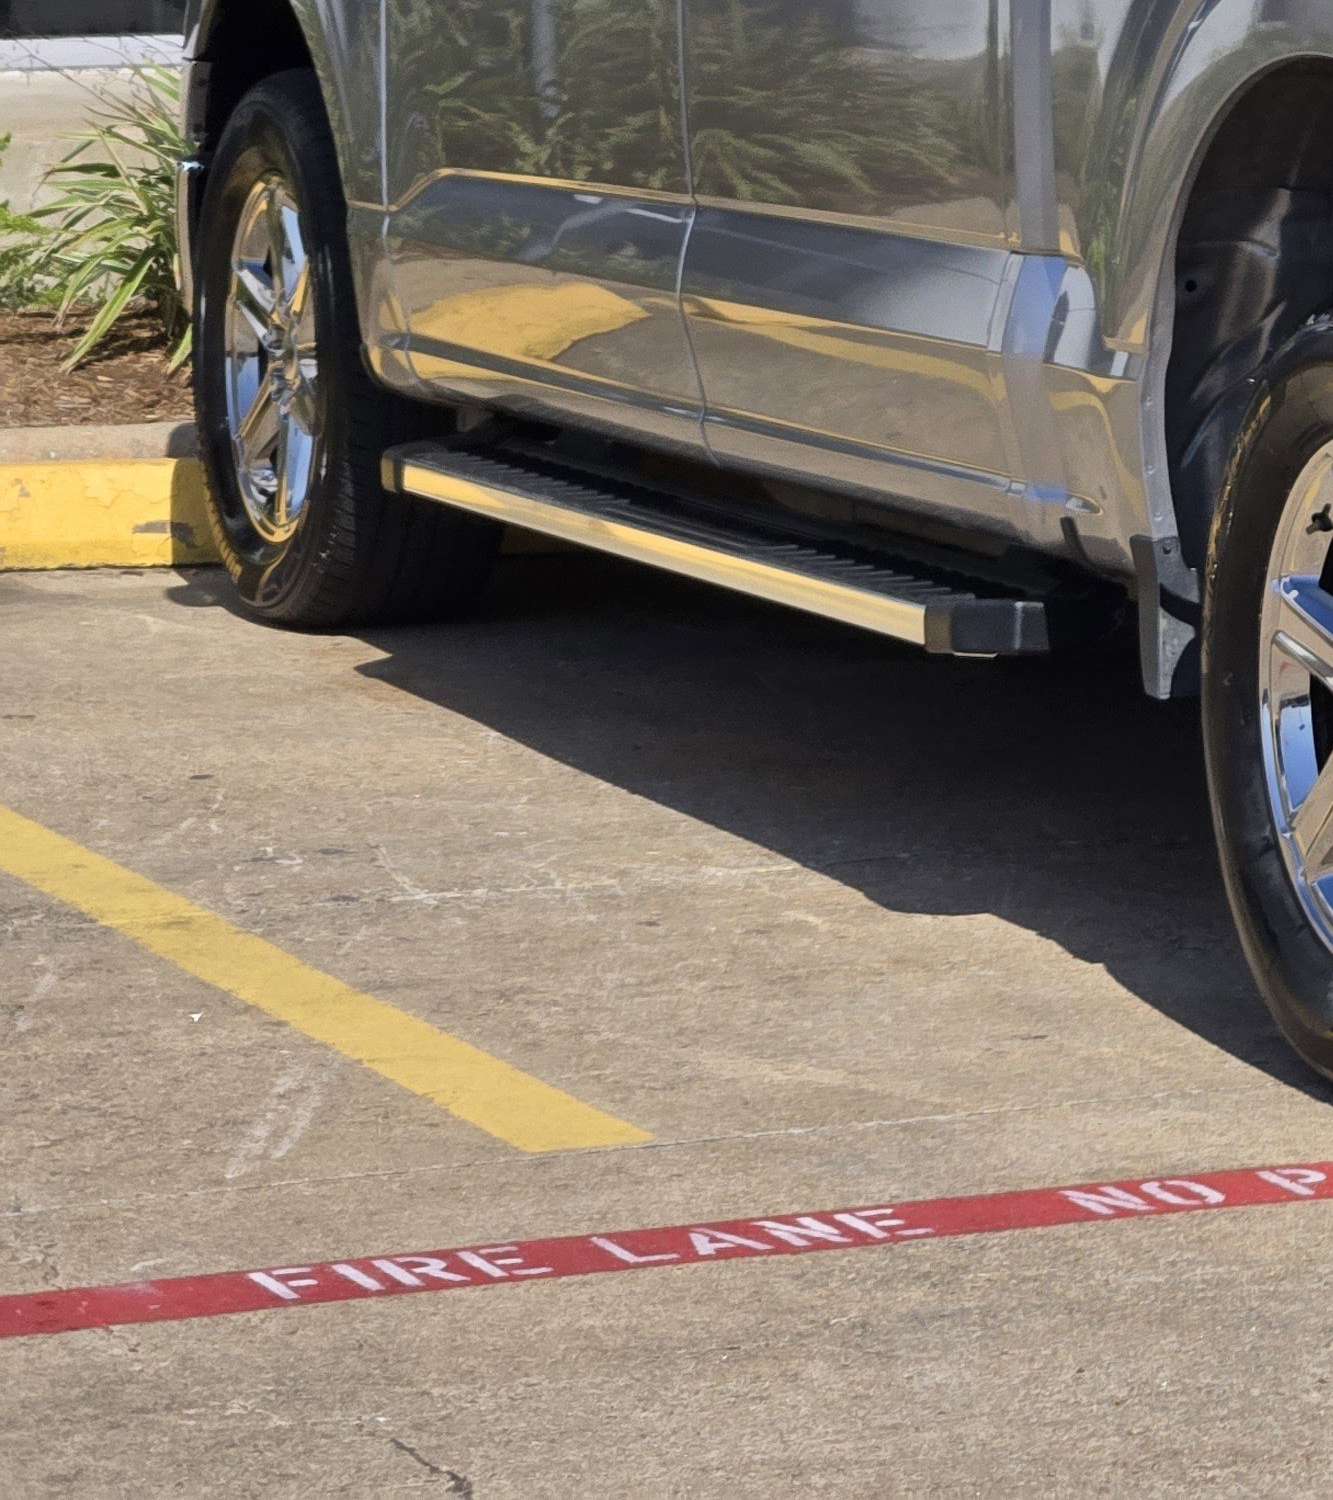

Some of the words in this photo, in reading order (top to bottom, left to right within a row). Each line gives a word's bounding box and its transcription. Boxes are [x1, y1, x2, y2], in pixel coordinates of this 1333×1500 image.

[248, 1244, 555, 1300] FIRE
[589, 1206, 936, 1264] LANE
[1058, 1178, 1227, 1217] NO
